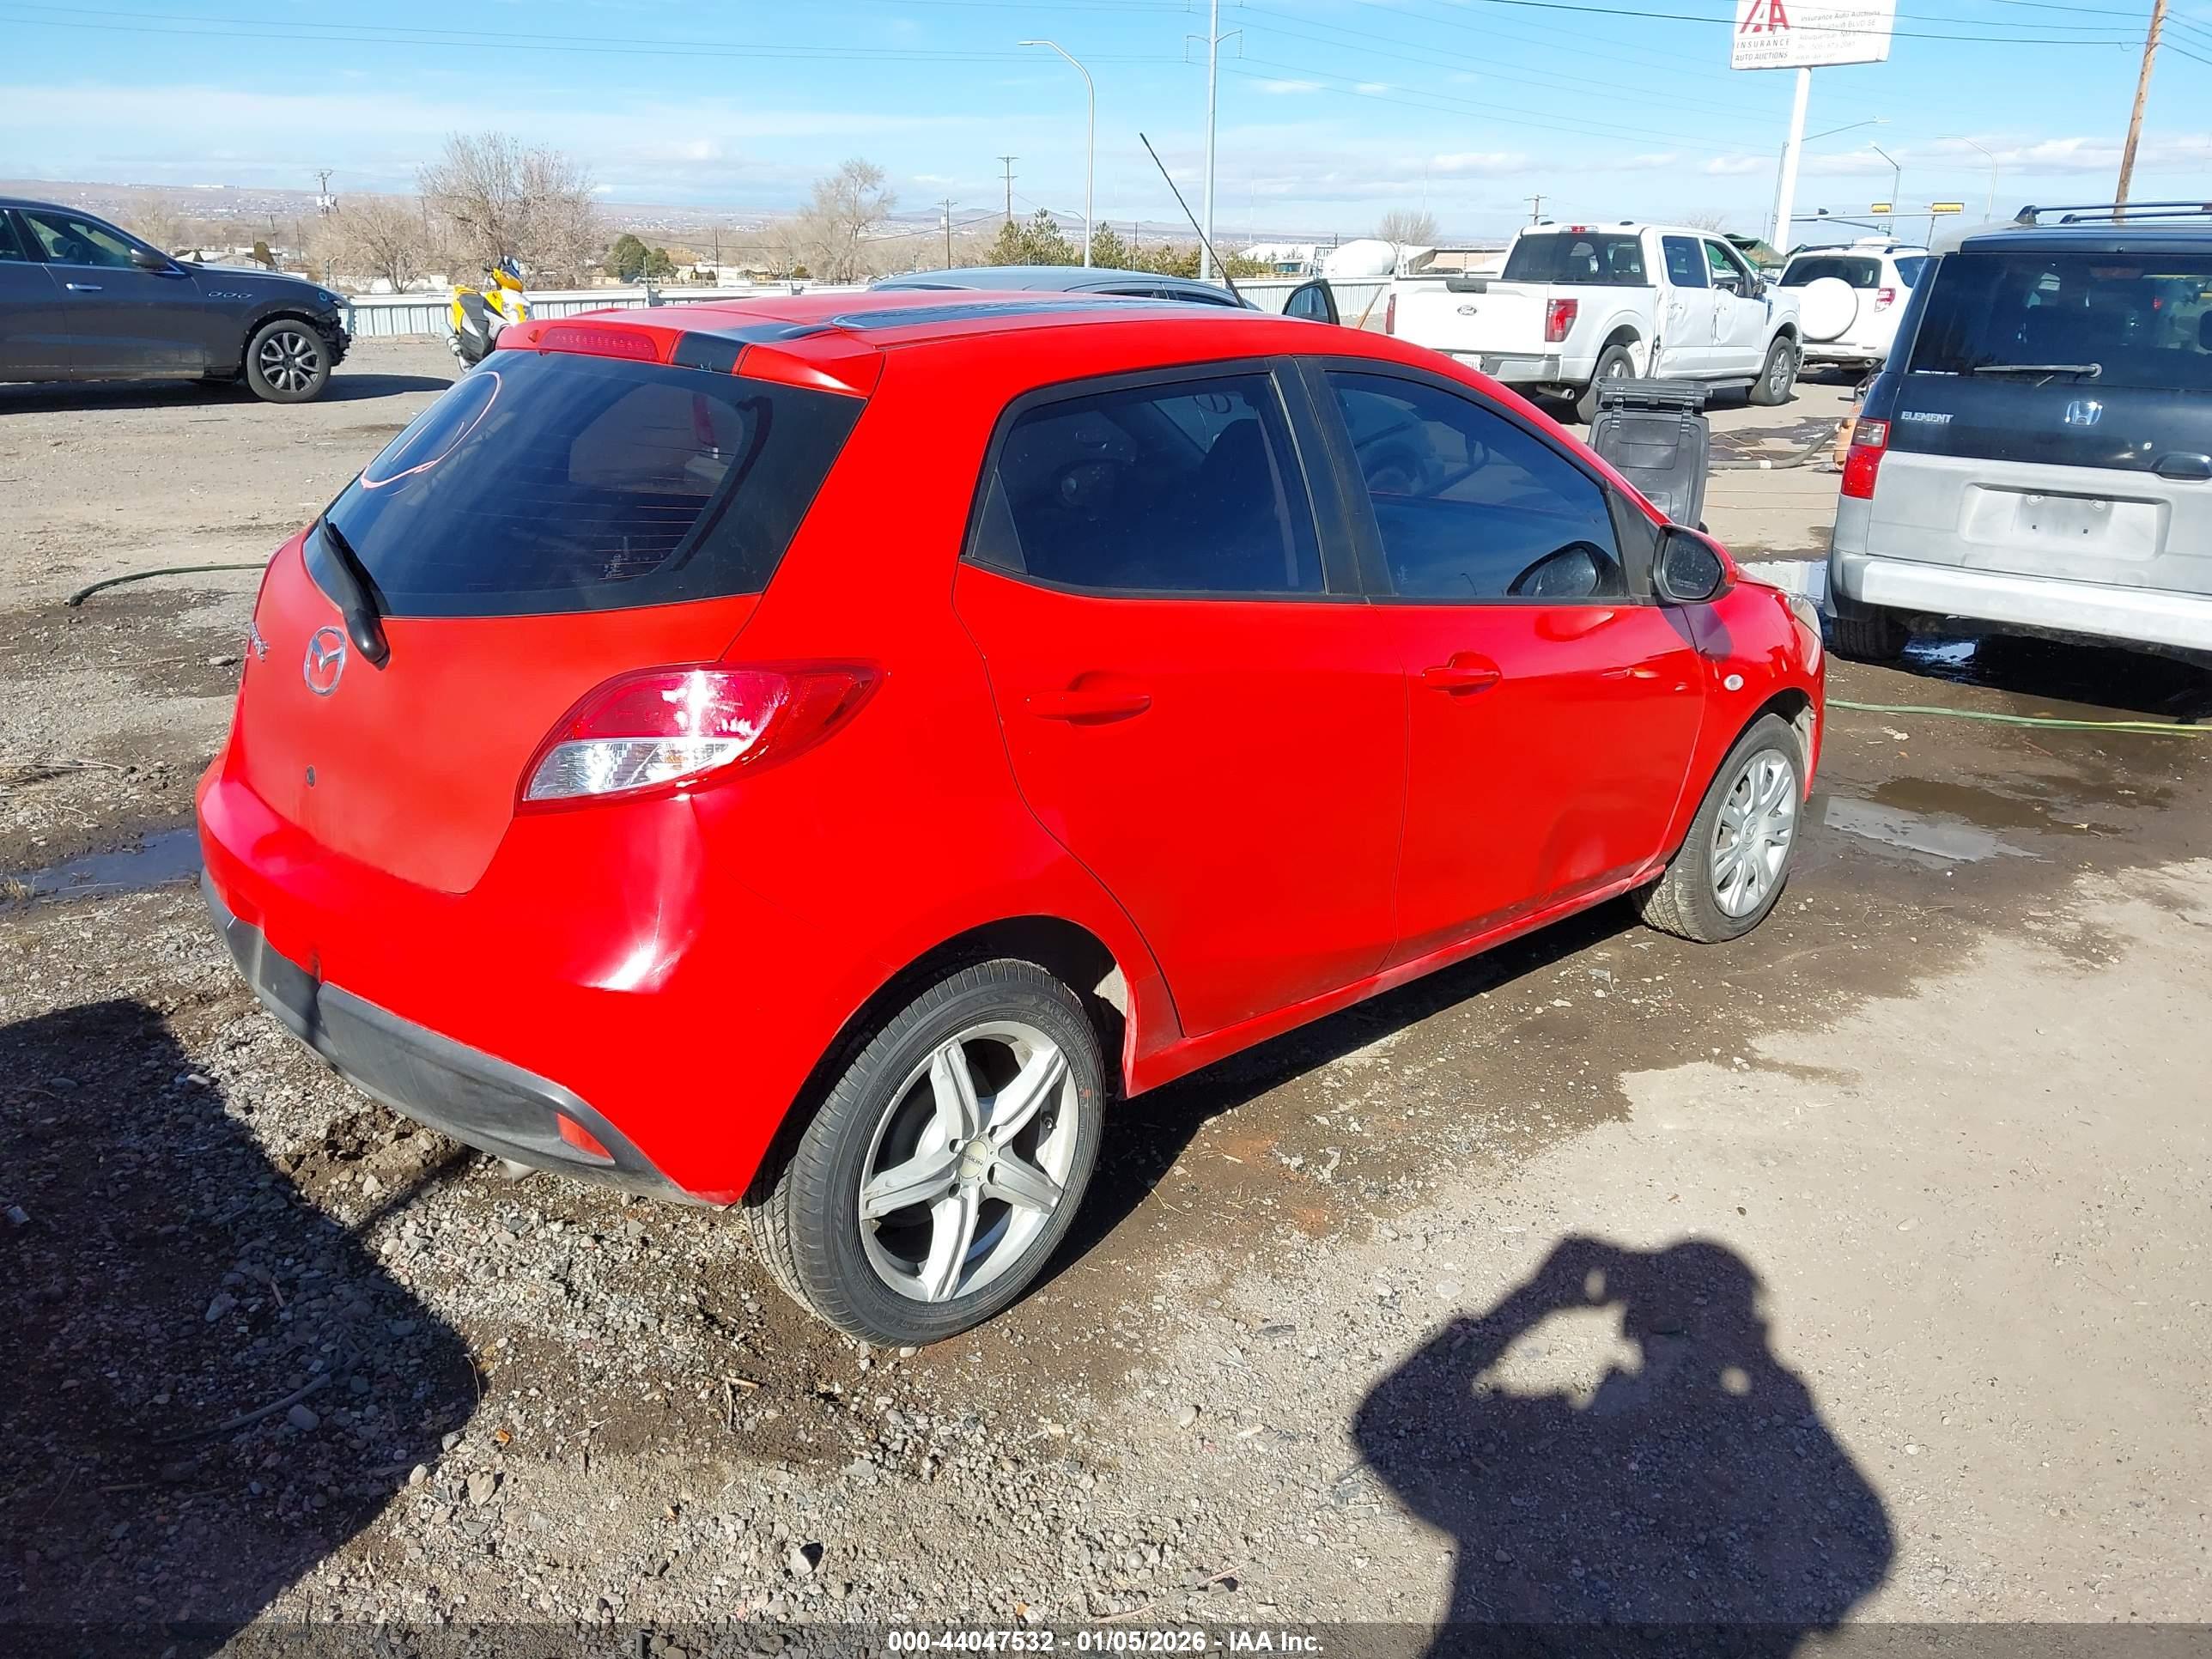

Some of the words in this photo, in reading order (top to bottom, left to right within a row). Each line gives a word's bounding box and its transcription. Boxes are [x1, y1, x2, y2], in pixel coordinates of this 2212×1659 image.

[1736, 38, 1790, 49] INSURANCE
[1735, 52, 1753, 62] AUTO
[1754, 51, 1789, 61] AUCTIONS
[1900, 410, 1954, 423] ELEMENT
